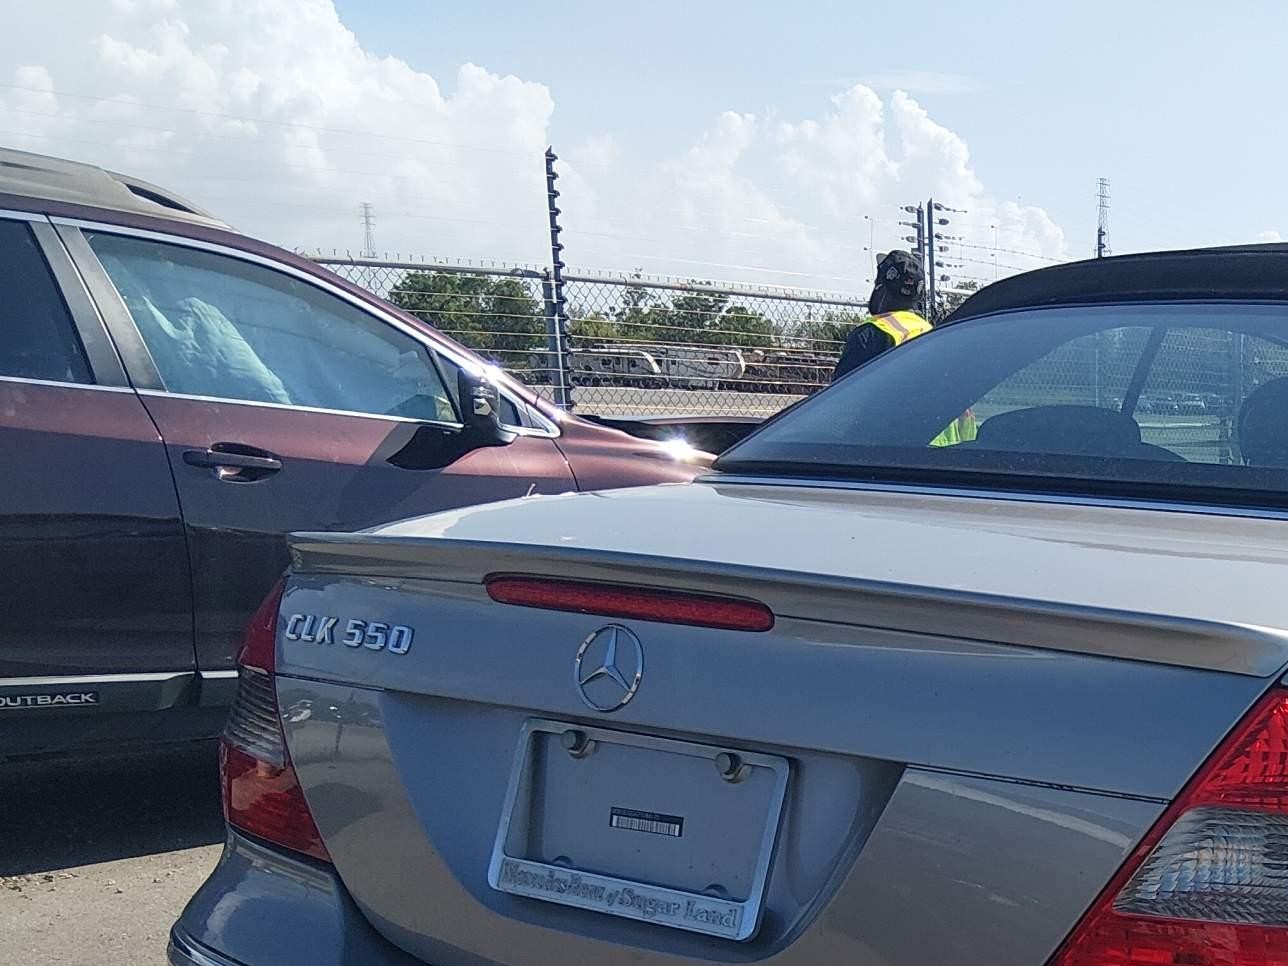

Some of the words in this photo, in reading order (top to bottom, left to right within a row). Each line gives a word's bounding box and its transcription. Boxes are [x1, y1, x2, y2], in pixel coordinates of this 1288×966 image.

[285, 614, 339, 644] CLK
[342, 619, 415, 655] 550
[619, 887, 681, 917] Sugar
[685, 899, 738, 928] Land
